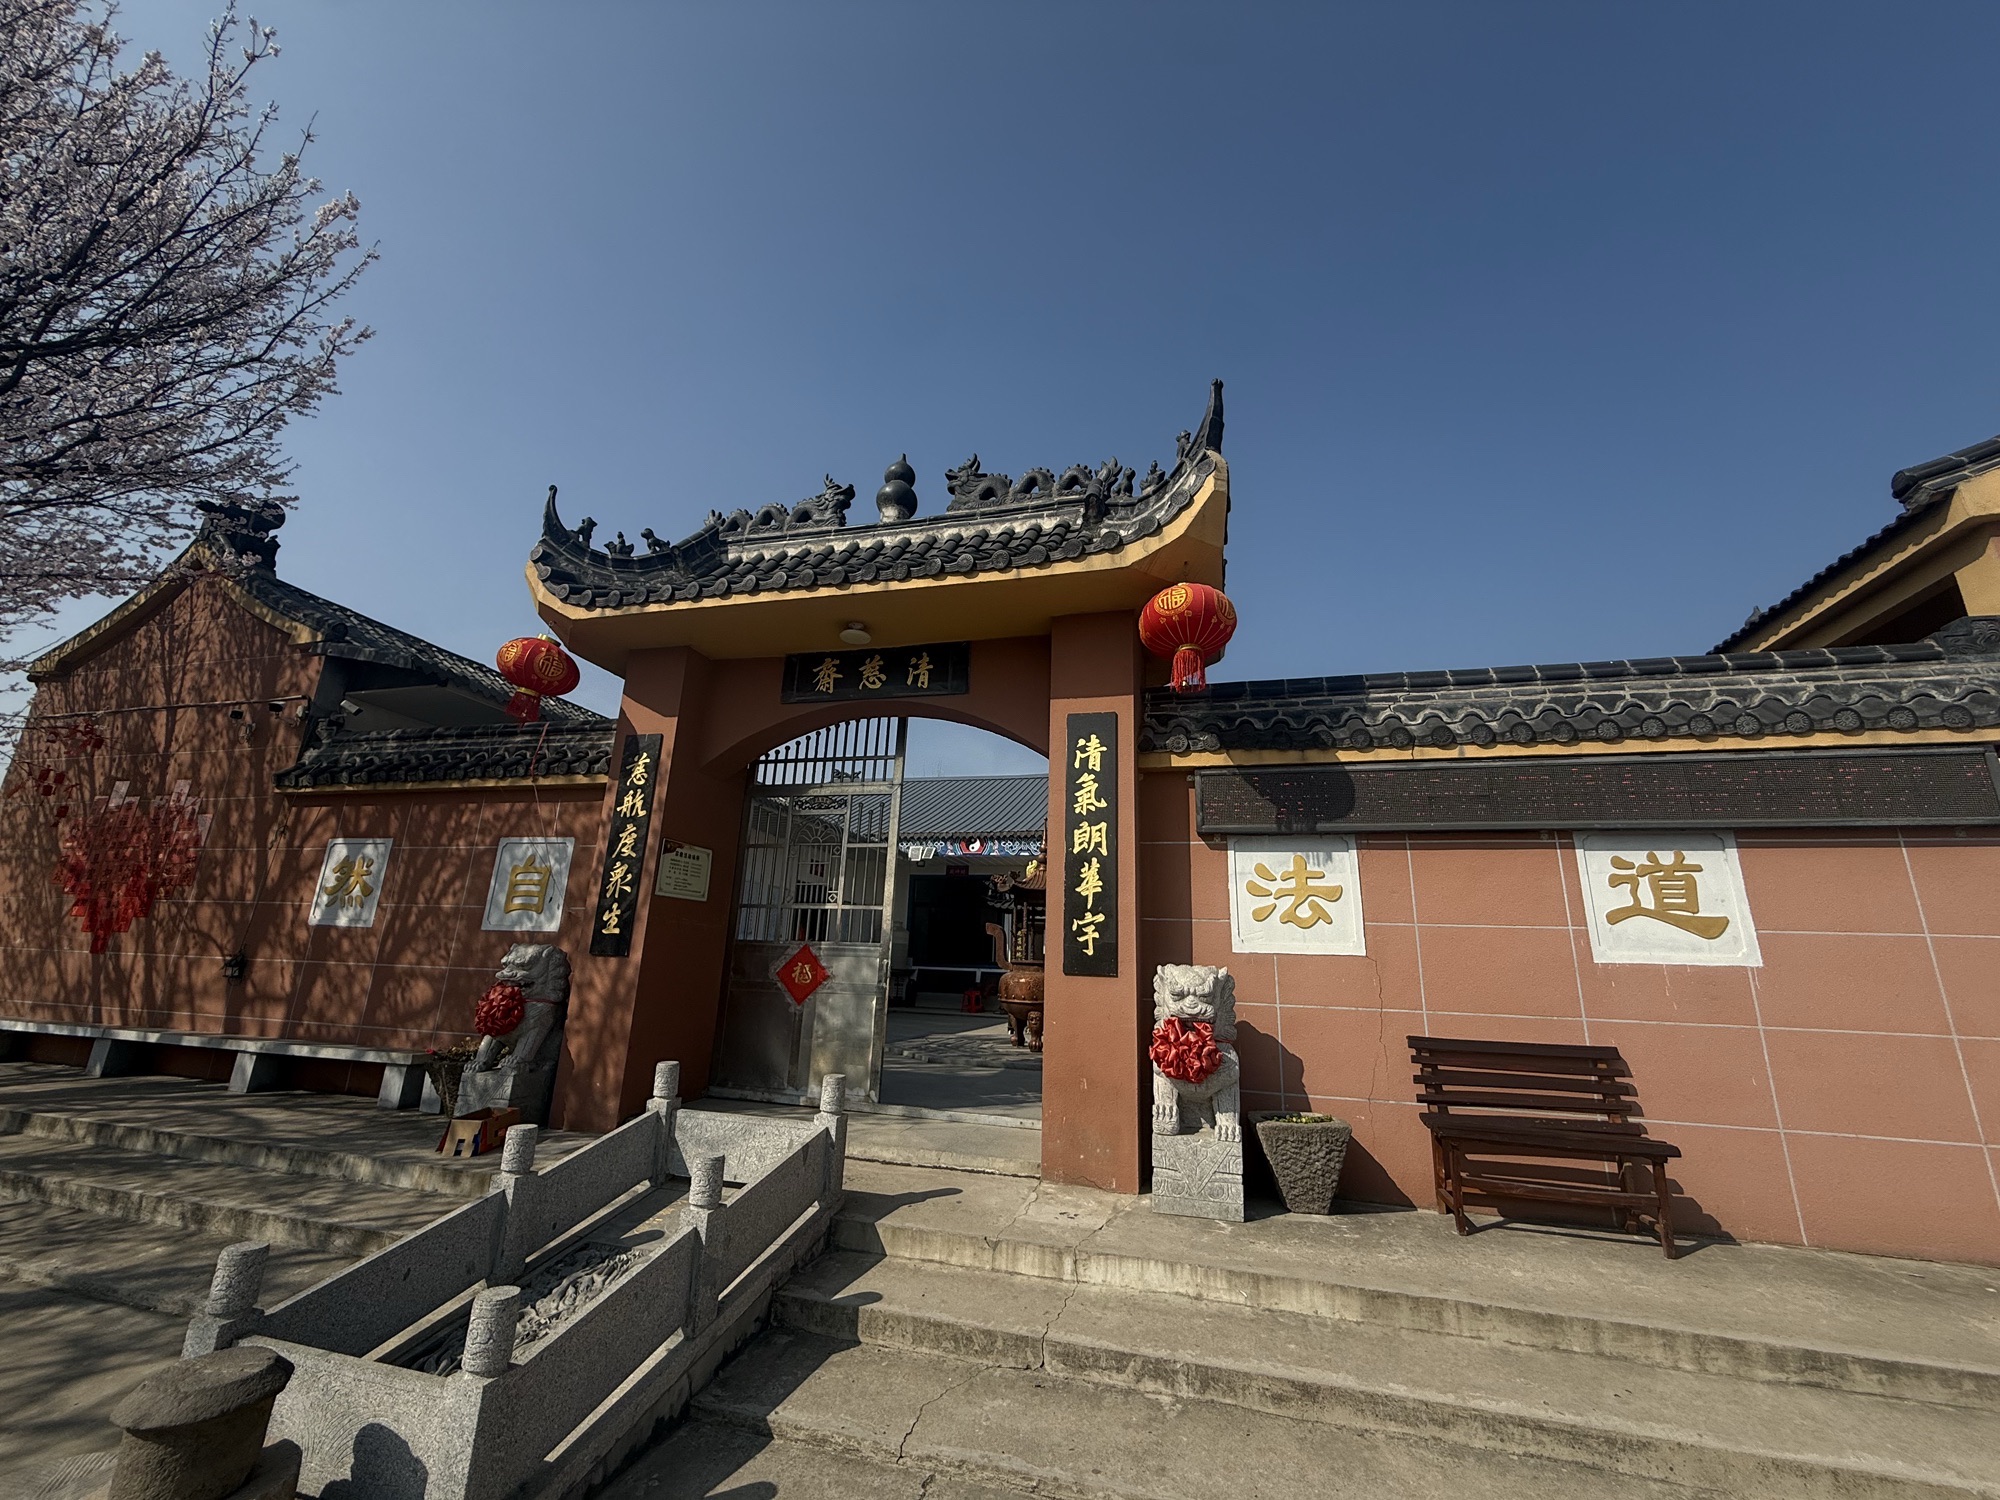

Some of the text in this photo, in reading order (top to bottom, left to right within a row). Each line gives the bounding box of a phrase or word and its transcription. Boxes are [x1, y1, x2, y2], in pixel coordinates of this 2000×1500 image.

[1158, 588, 1187, 610] 福
[539, 655, 564, 677] 福
[323, 854, 374, 909] 然
[504, 854, 552, 914] 自
[1245, 854, 1343, 929] 法
[1605, 850, 1730, 939] 道
